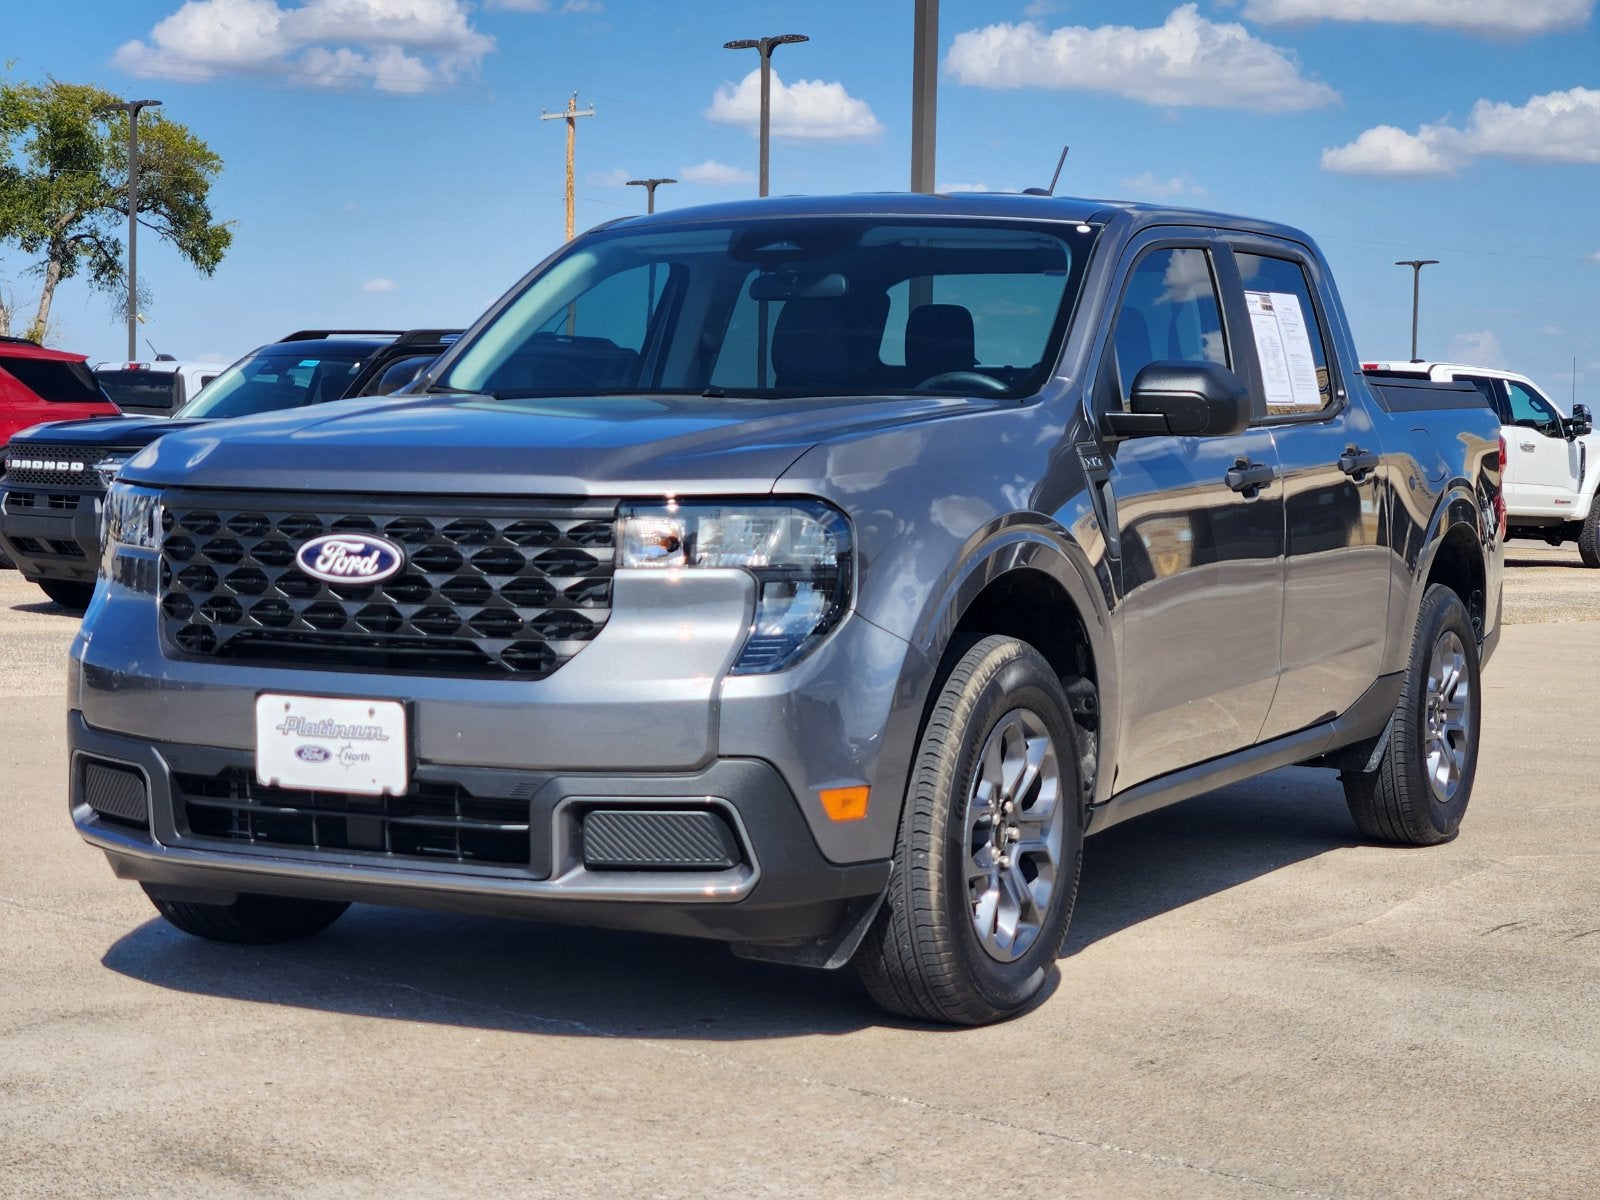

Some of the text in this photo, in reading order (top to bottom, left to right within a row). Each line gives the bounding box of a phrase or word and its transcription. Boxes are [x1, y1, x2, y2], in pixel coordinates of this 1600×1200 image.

[11, 459, 84, 472] BRONCO
[315, 541, 381, 575] Ford
[275, 715, 389, 741] Platinum
[344, 750, 371, 762] North
